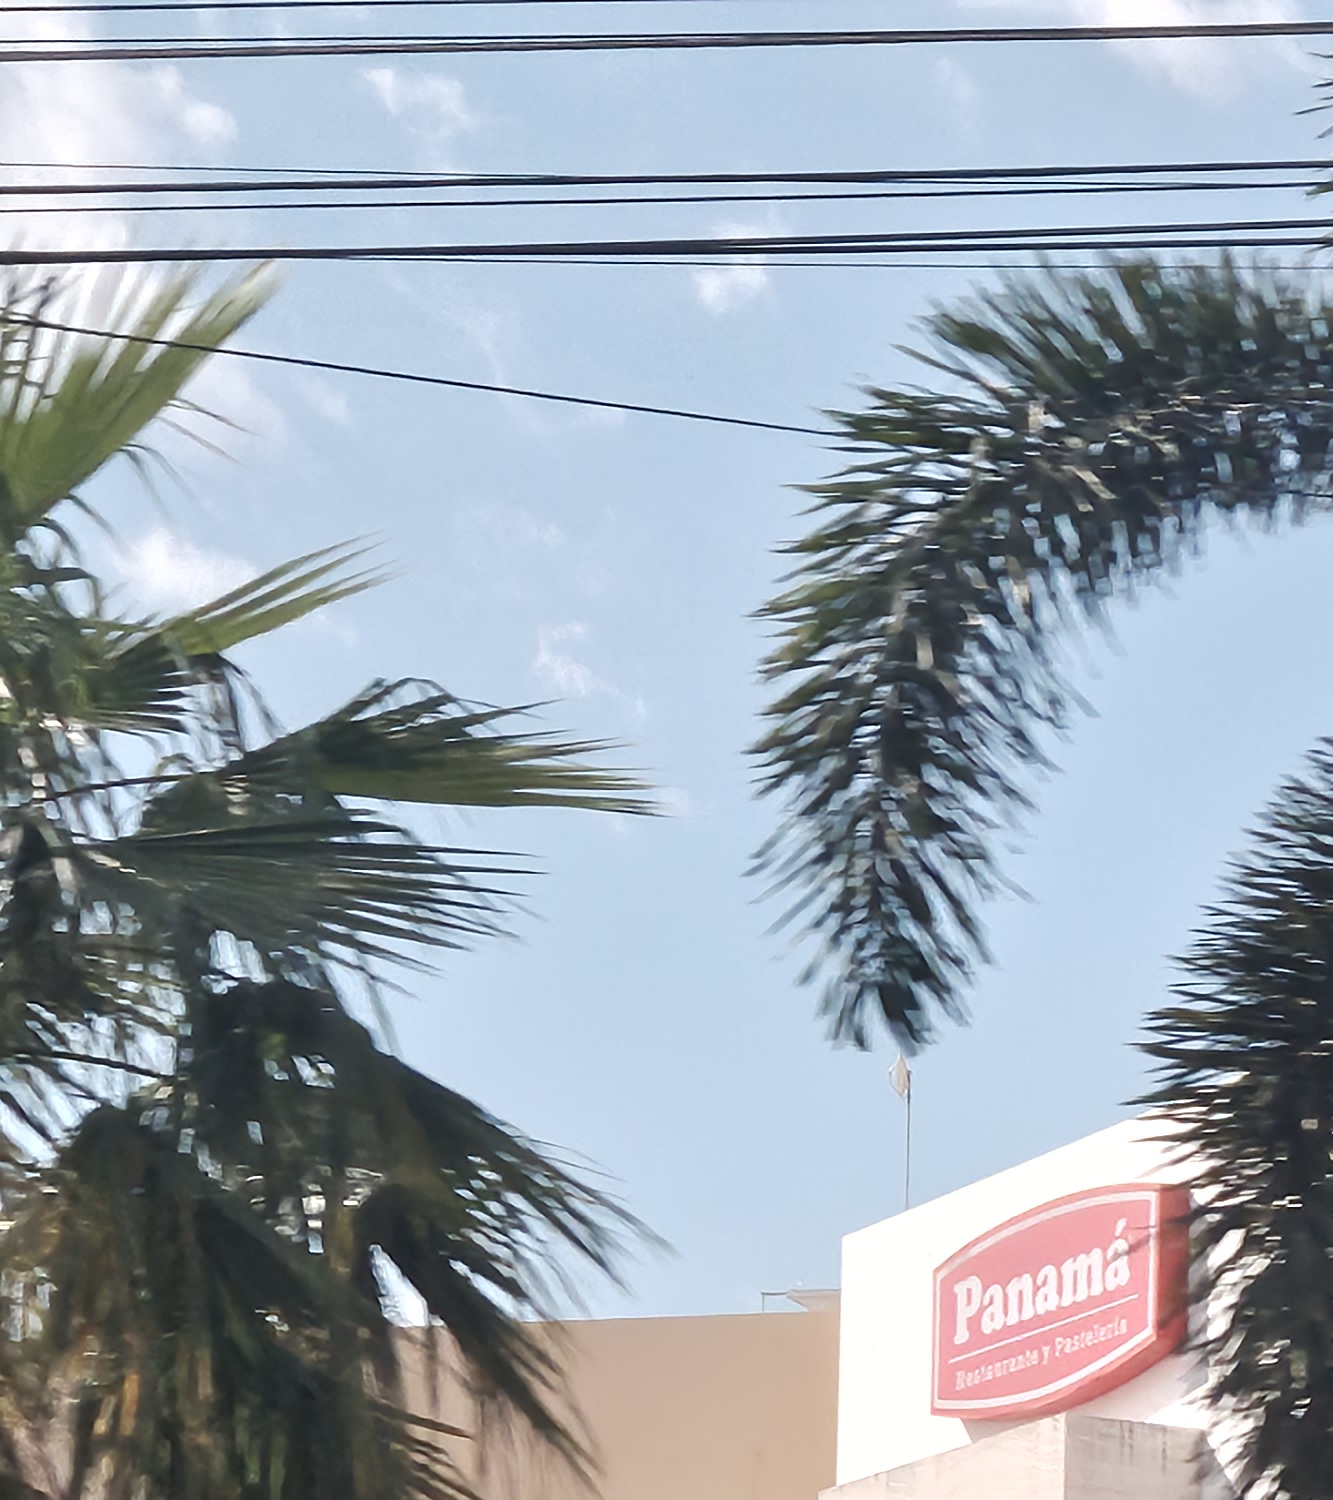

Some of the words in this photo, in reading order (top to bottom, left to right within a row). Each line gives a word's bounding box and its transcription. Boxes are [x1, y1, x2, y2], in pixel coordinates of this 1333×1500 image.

[953, 1217, 1131, 1345] Panamá
[956, 1350, 1038, 1390] Restaurante
[1041, 1345, 1051, 1366] y
